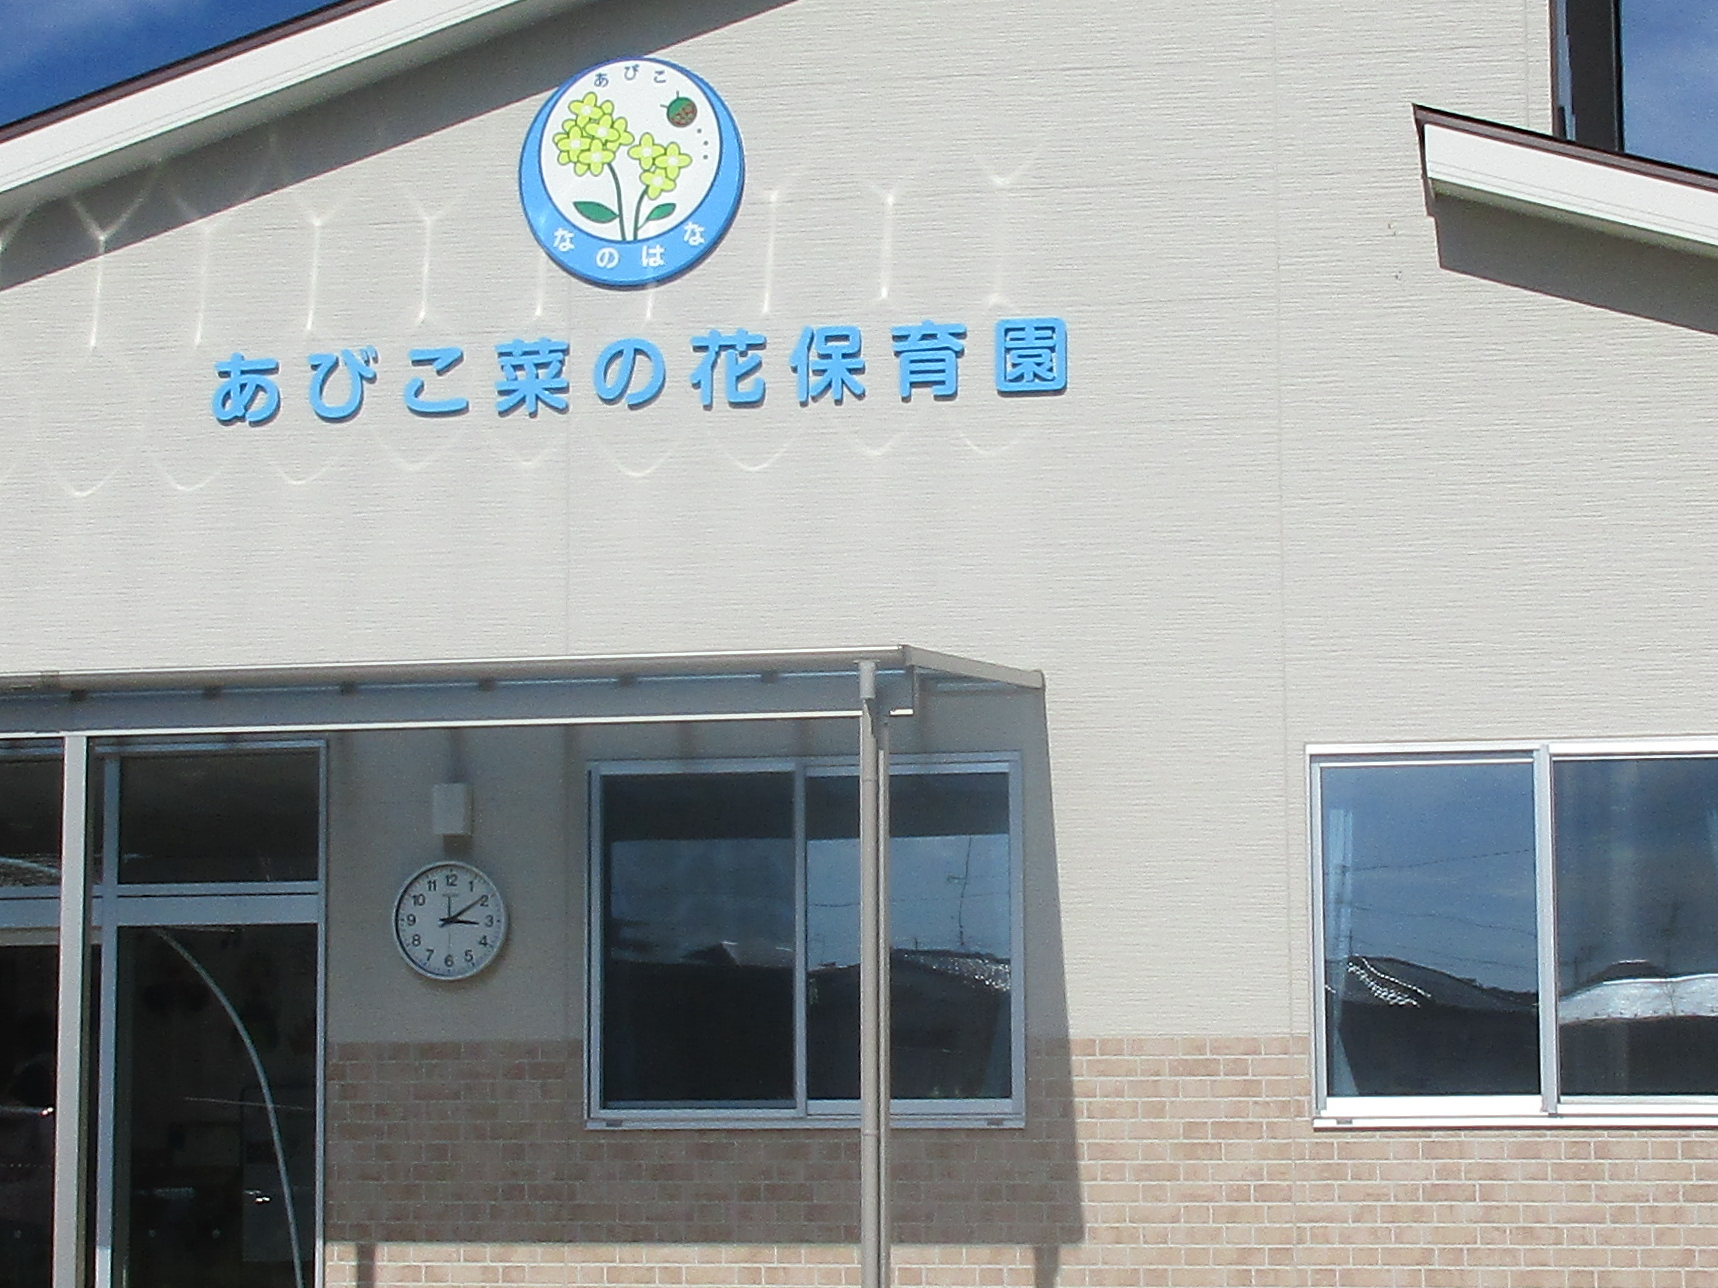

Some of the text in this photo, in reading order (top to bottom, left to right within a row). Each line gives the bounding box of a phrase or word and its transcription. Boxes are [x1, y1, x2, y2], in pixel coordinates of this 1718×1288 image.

[593, 63, 668, 88] あびこ
[552, 221, 707, 270] なのはな
[212, 317, 1068, 424] あびこ菜の花保育園
[427, 880, 437, 892] 11
[445, 873, 458, 887] 12
[469, 881, 474, 892] 1
[412, 893, 426, 906] 10
[407, 914, 417, 926] 9
[485, 915, 494, 927] 3
[411, 934, 422, 947] 8
[478, 935, 488, 947] 4
[425, 949, 435, 962] 7
[444, 954, 454, 967] 6
[464, 949, 474, 962] 5
